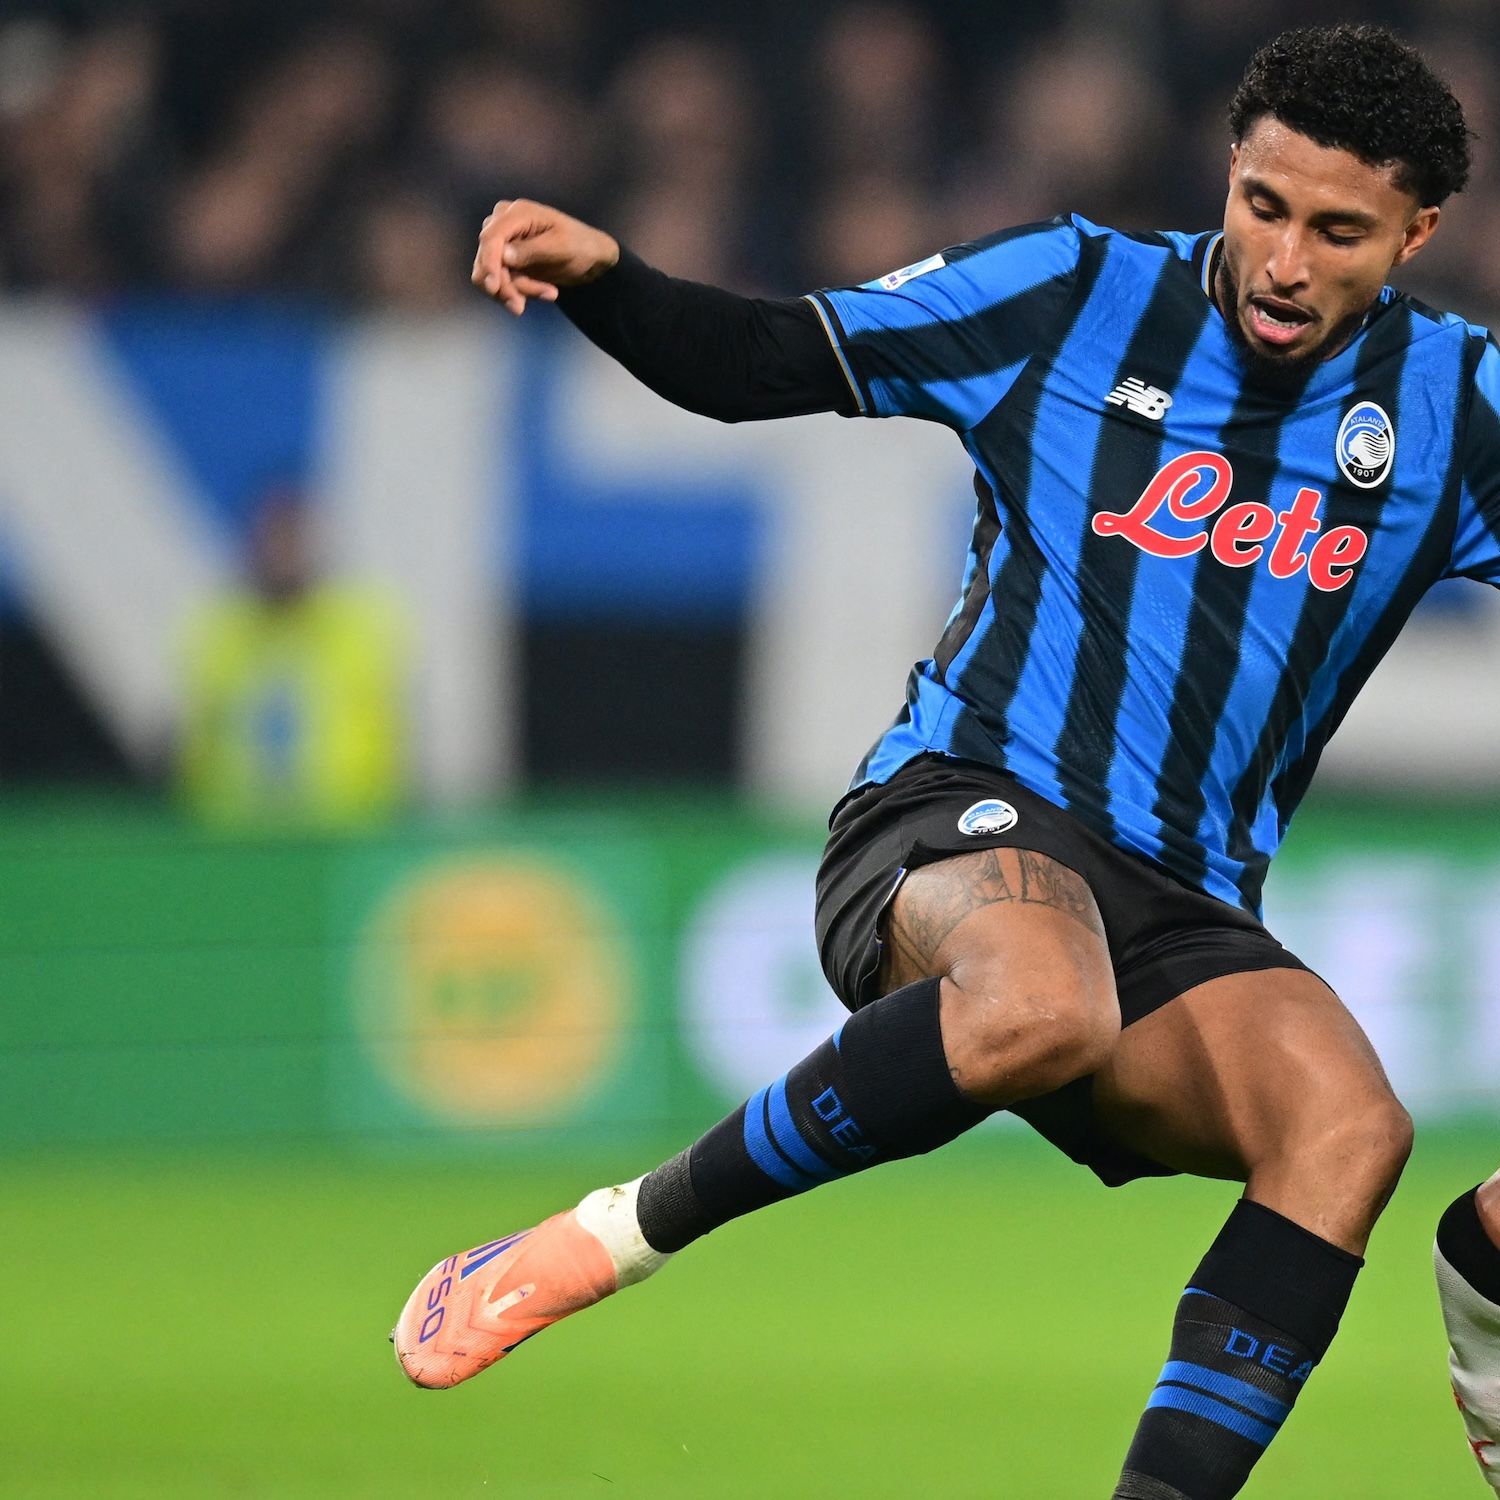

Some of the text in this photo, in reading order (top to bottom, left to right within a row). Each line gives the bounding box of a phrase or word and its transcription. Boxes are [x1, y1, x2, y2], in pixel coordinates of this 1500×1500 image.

[1350, 415, 1386, 429] ATALANTA
[1352, 467, 1375, 477] 1907
[1092, 451, 1367, 592] Lete
[1223, 1327, 1313, 1384] DEA
